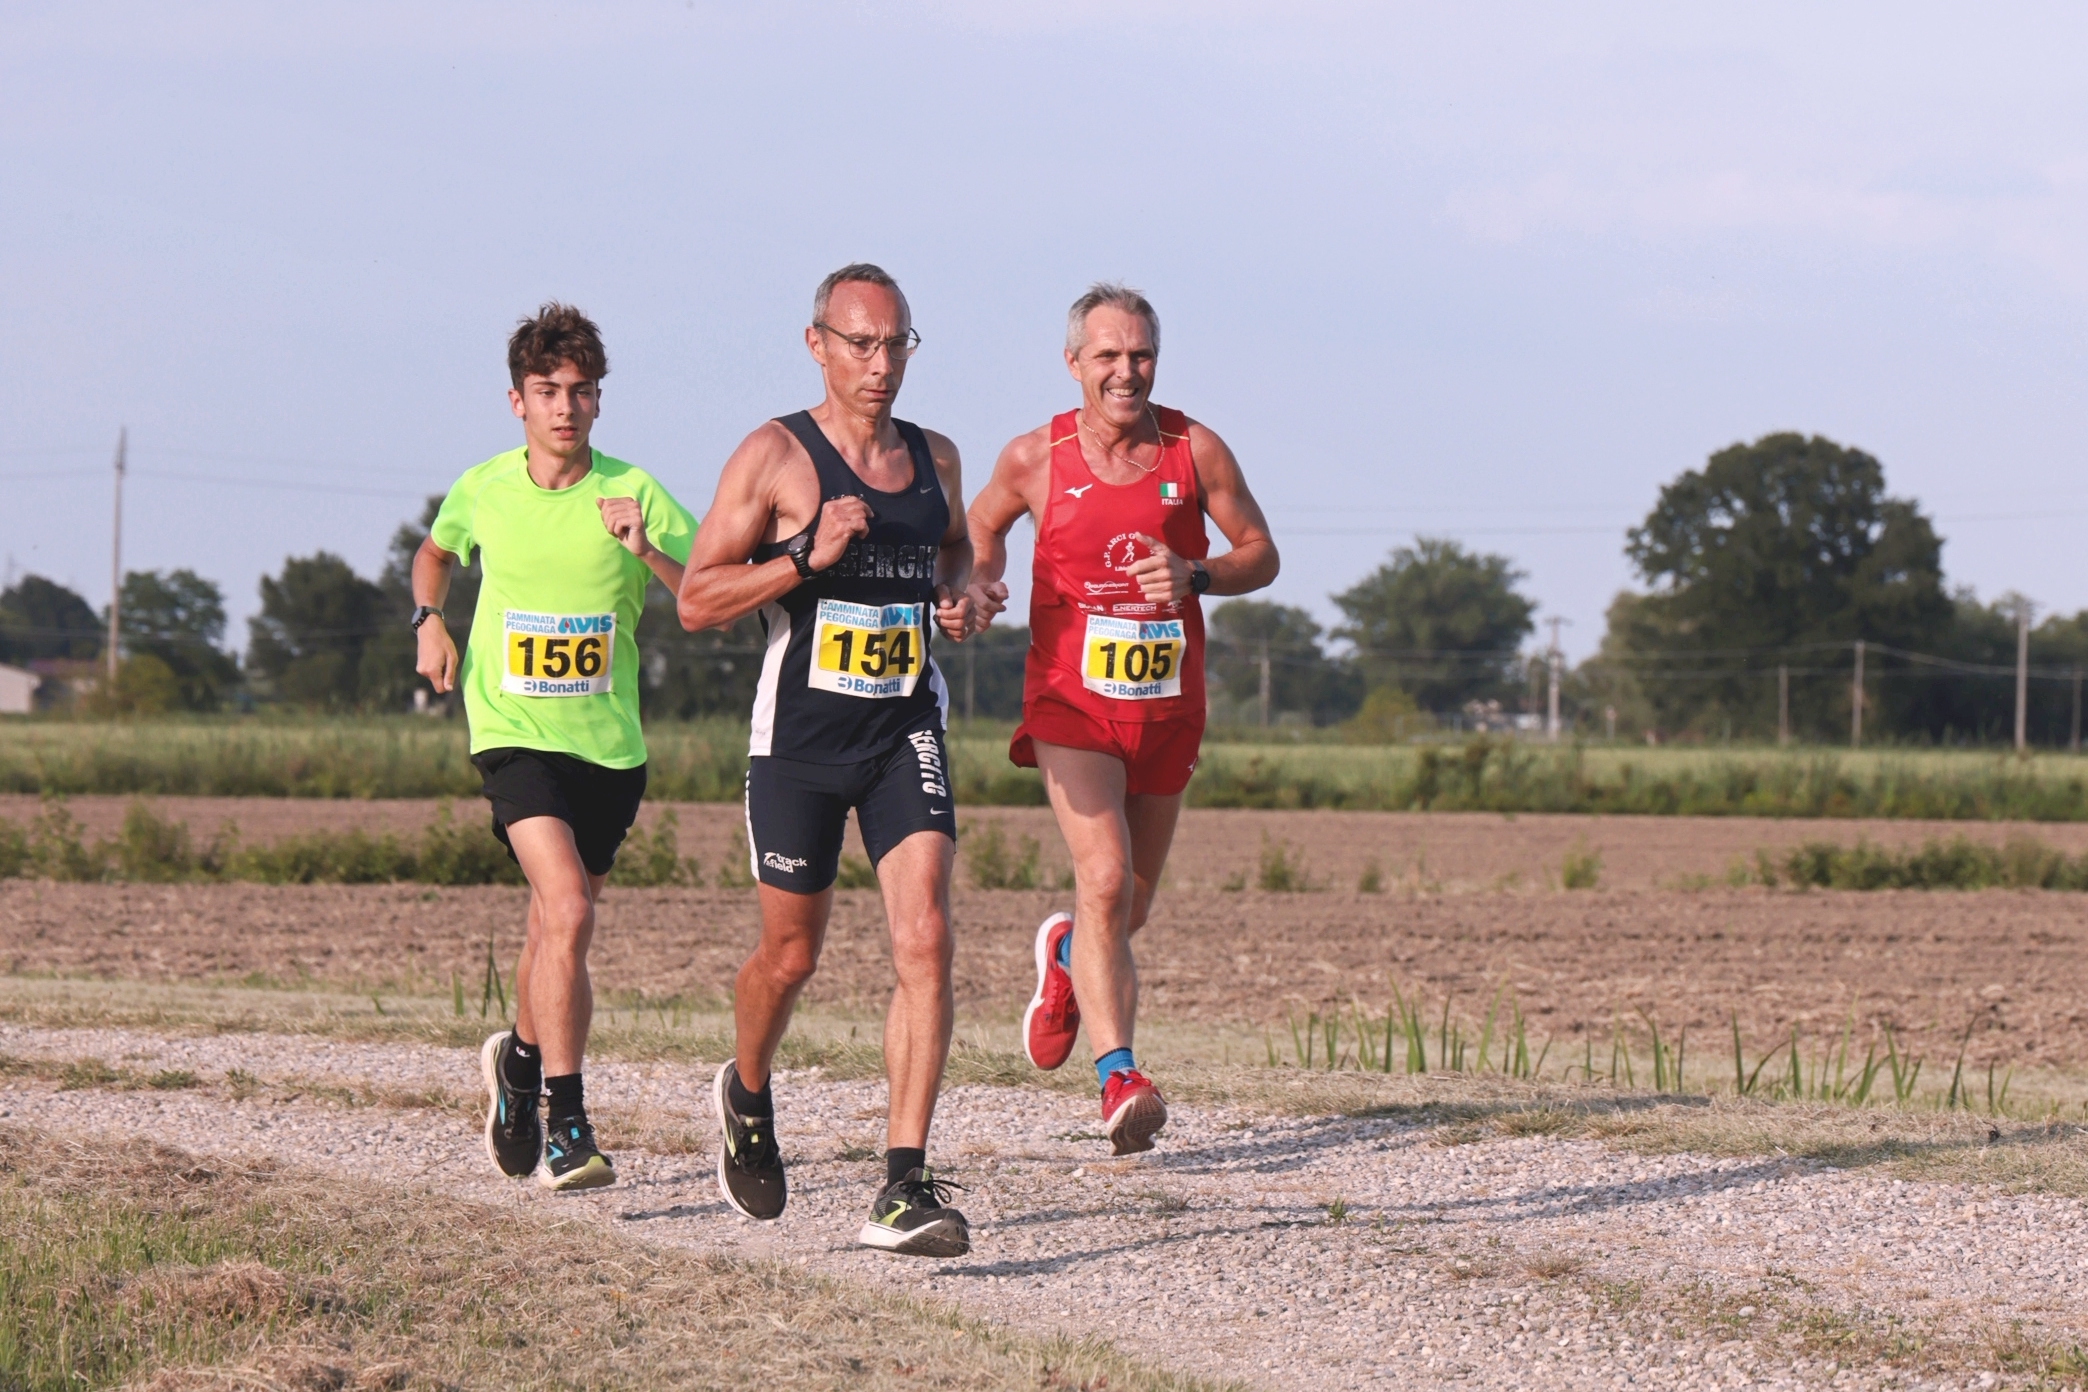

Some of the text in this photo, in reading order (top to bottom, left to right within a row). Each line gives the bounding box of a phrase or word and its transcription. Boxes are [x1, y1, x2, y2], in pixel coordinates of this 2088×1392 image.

[1161, 498, 1183, 506] ITALIA
[1107, 533, 1127, 551] ARCI
[820, 600, 921, 627] CAMMINATA AVIS
[820, 611, 879, 628] PEGOGNAGA
[505, 620, 556, 634] PEGOGNAGA
[506, 611, 612, 634] CAMMINATA AVIS
[1089, 616, 1181, 639] CAMMINATA AVIS
[1088, 625, 1137, 639] PEGOGNAGA
[517, 637, 602, 678] 156
[833, 630, 915, 677] 154
[1100, 642, 1172, 682] 105
[538, 680, 589, 693] Bonatti
[854, 679, 900, 694] Bonatti
[1118, 683, 1161, 696] Bonatti
[776, 853, 808, 867] track
